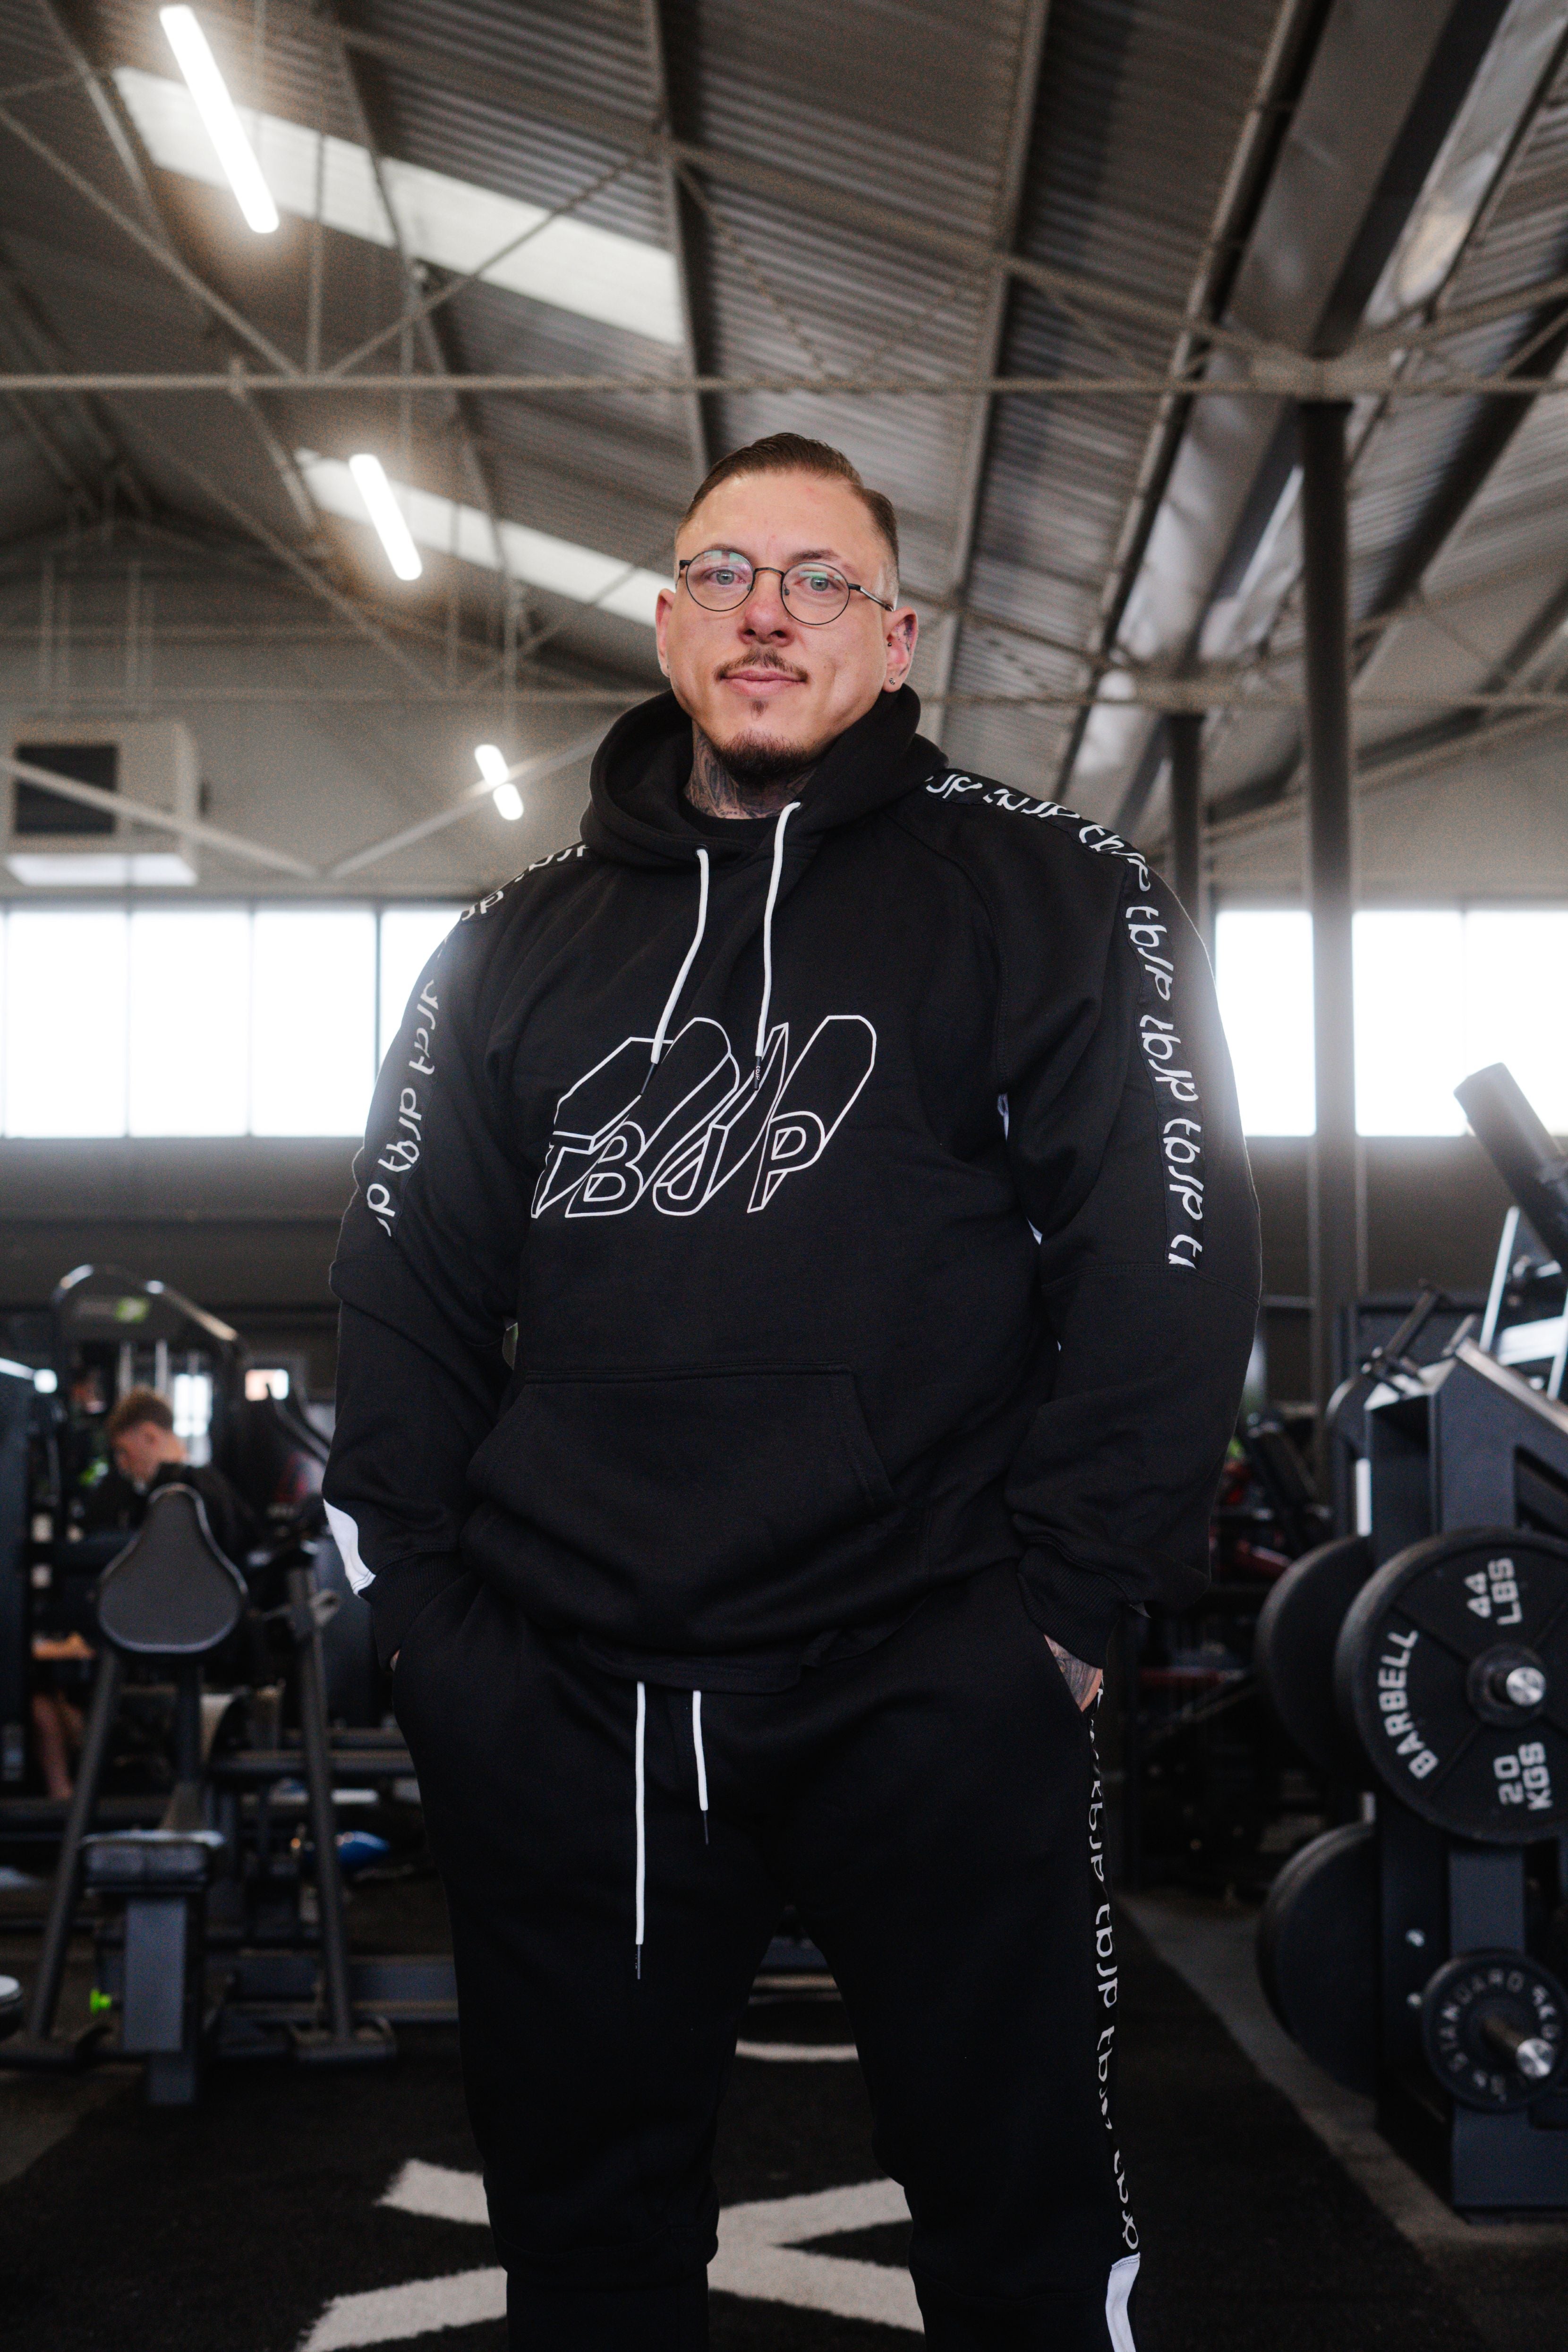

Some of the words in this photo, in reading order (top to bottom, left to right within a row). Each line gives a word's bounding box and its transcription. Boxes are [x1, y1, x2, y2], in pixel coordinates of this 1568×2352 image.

[1464, 1571, 1491, 1619] 44
[1488, 1558, 1523, 1625] LBS
[1377, 1629, 1440, 1780] BARBELL
[1493, 1754, 1525, 1806] 20
[1517, 1742, 1553, 1811] KGS
